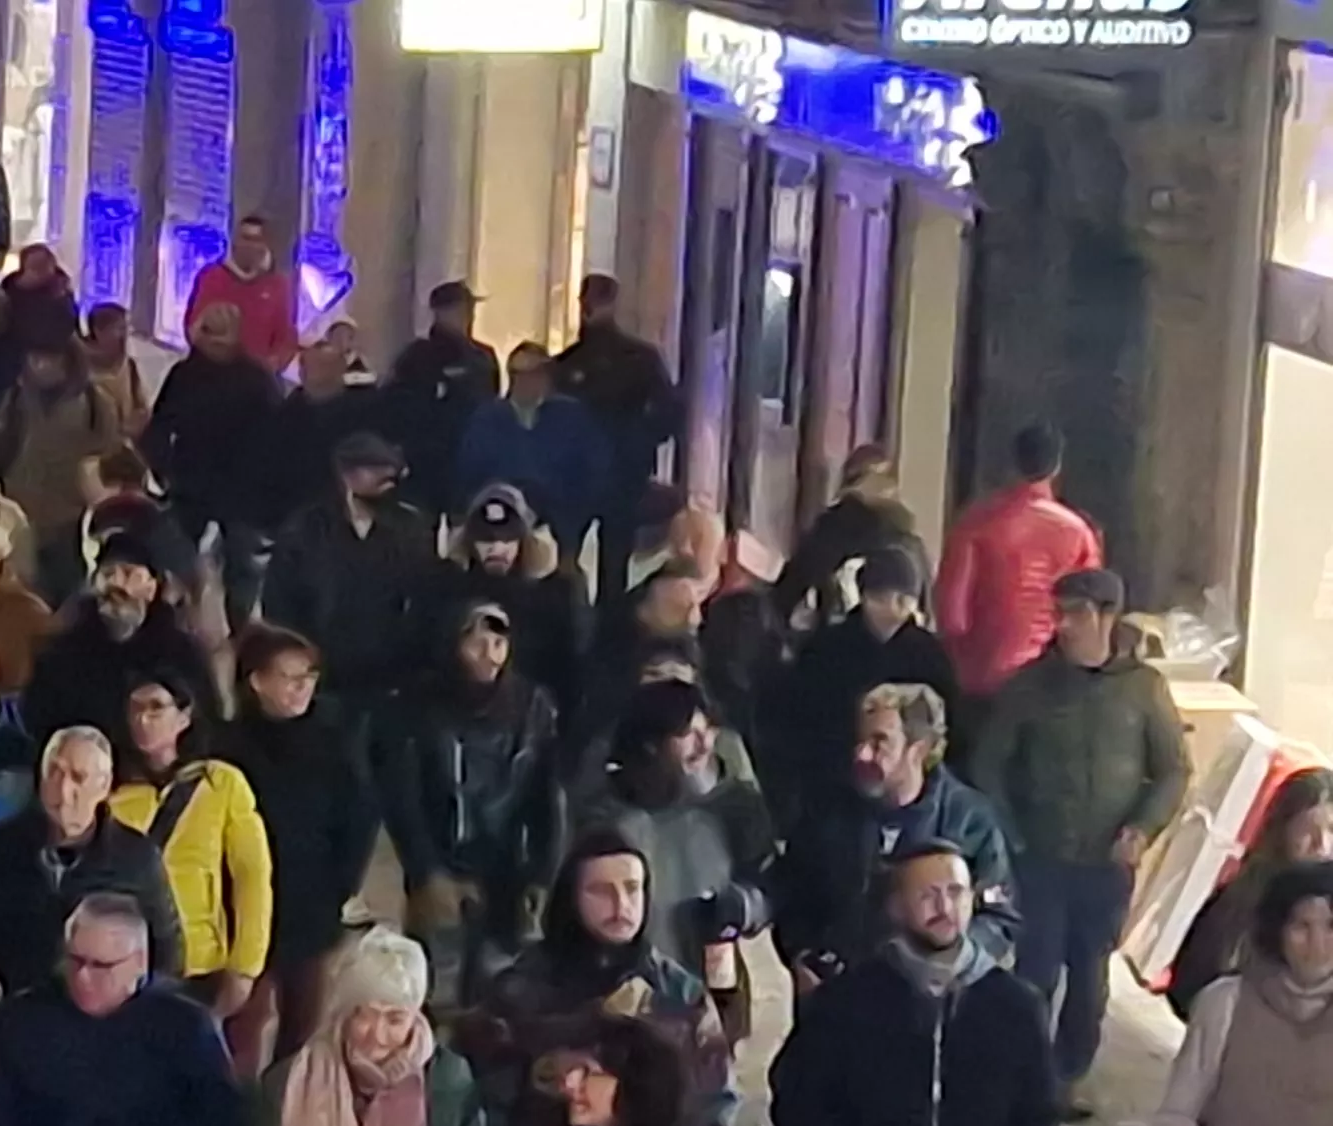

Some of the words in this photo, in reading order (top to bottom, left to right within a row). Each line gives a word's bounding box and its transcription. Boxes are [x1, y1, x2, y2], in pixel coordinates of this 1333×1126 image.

[901, 17, 987, 44] CENTRO
[990, 14, 1071, 44] ÓPTICO
[1073, 20, 1090, 44] Y
[1090, 20, 1192, 45] AUDITIVO
